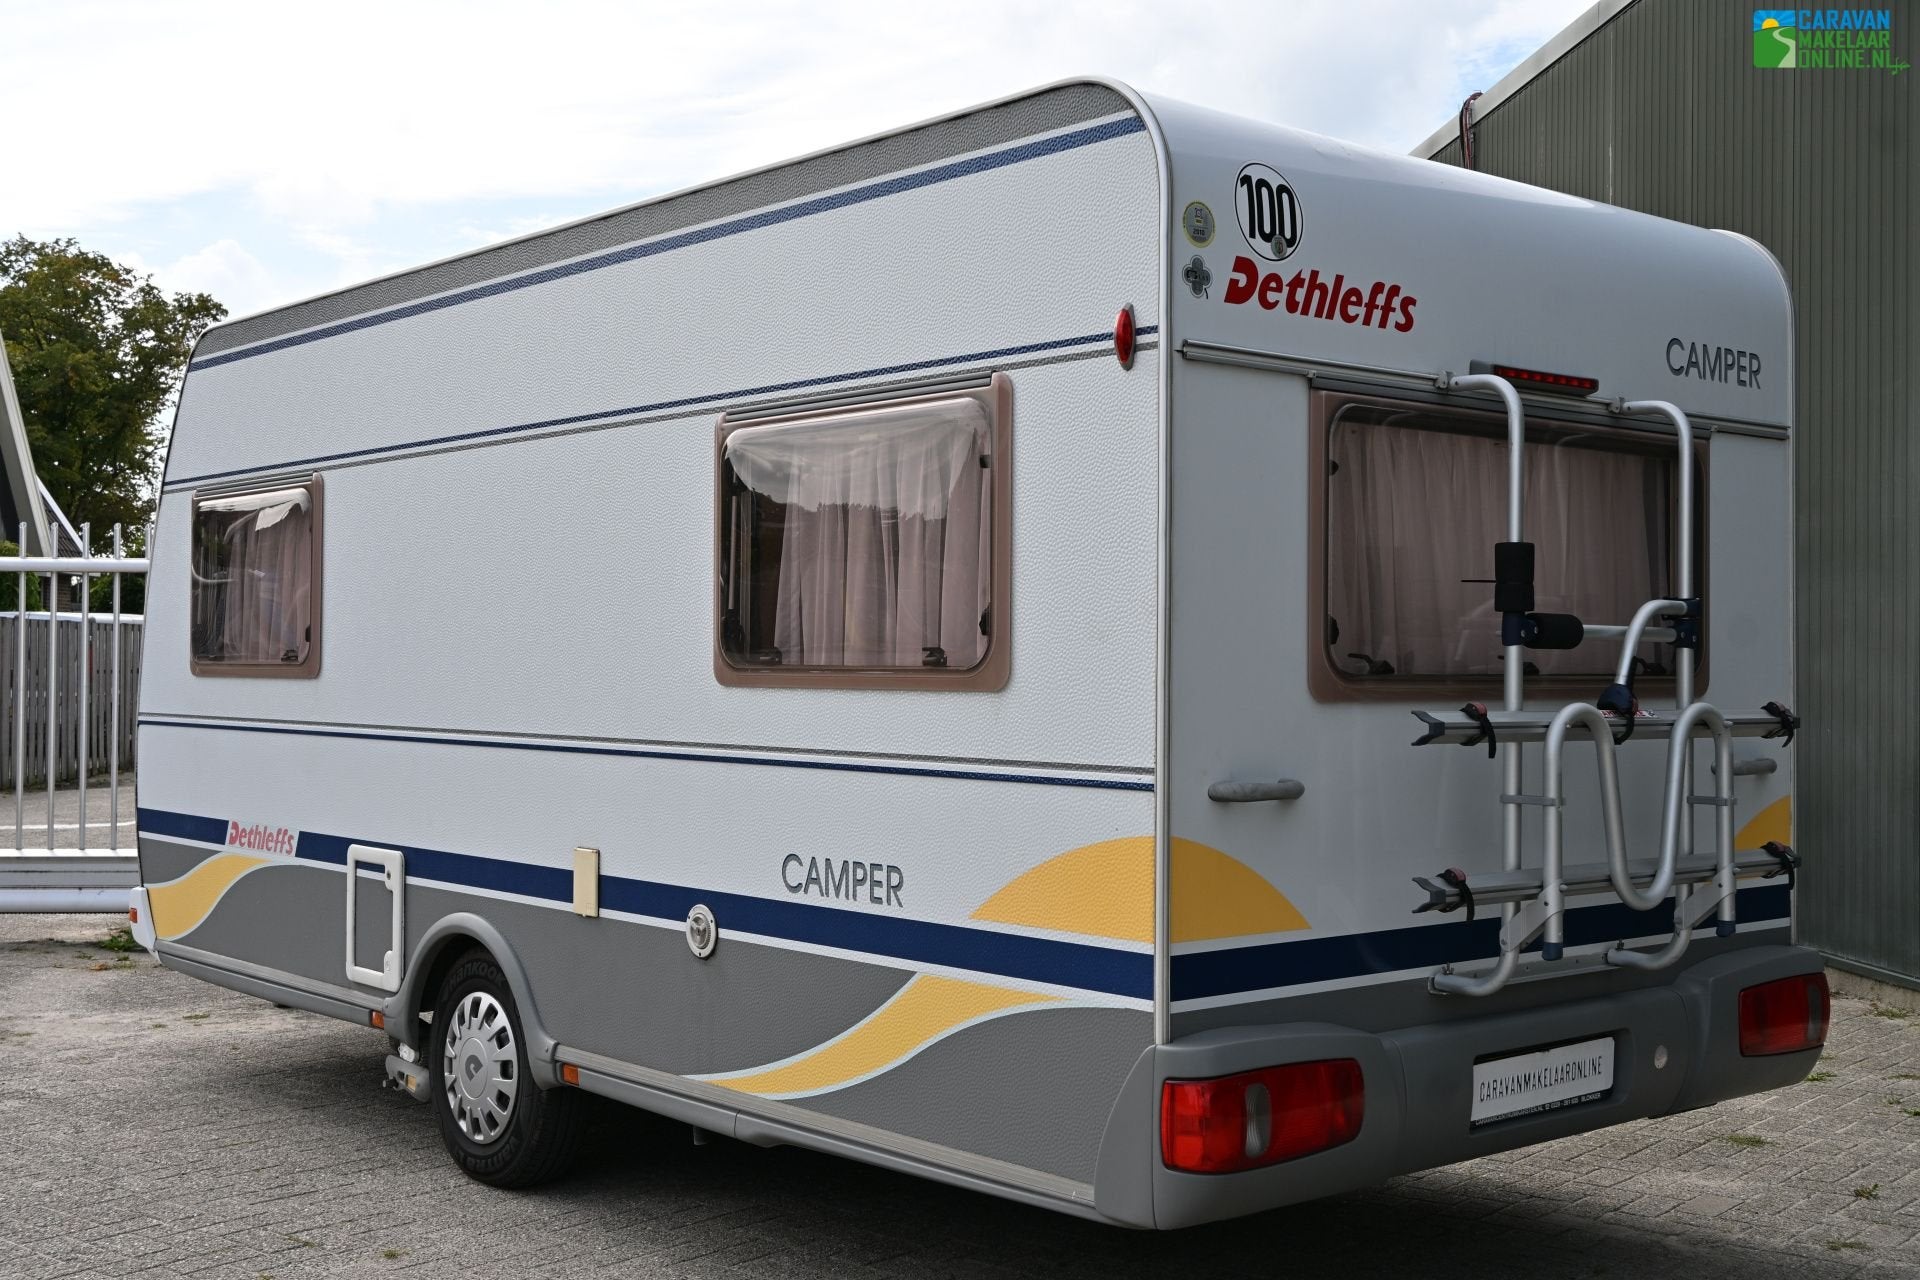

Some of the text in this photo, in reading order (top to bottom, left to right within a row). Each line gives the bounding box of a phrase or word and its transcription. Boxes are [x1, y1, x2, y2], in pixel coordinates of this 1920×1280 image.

[1240, 174, 1297, 248] 100
[1224, 255, 1417, 333] Dethleffs
[1666, 337, 1761, 389] CAMPER
[228, 820, 294, 856] Dethleffs
[781, 853, 904, 908] CAMPER
[1479, 1055, 1602, 1102] CARAVANMAKELAARONLINE
